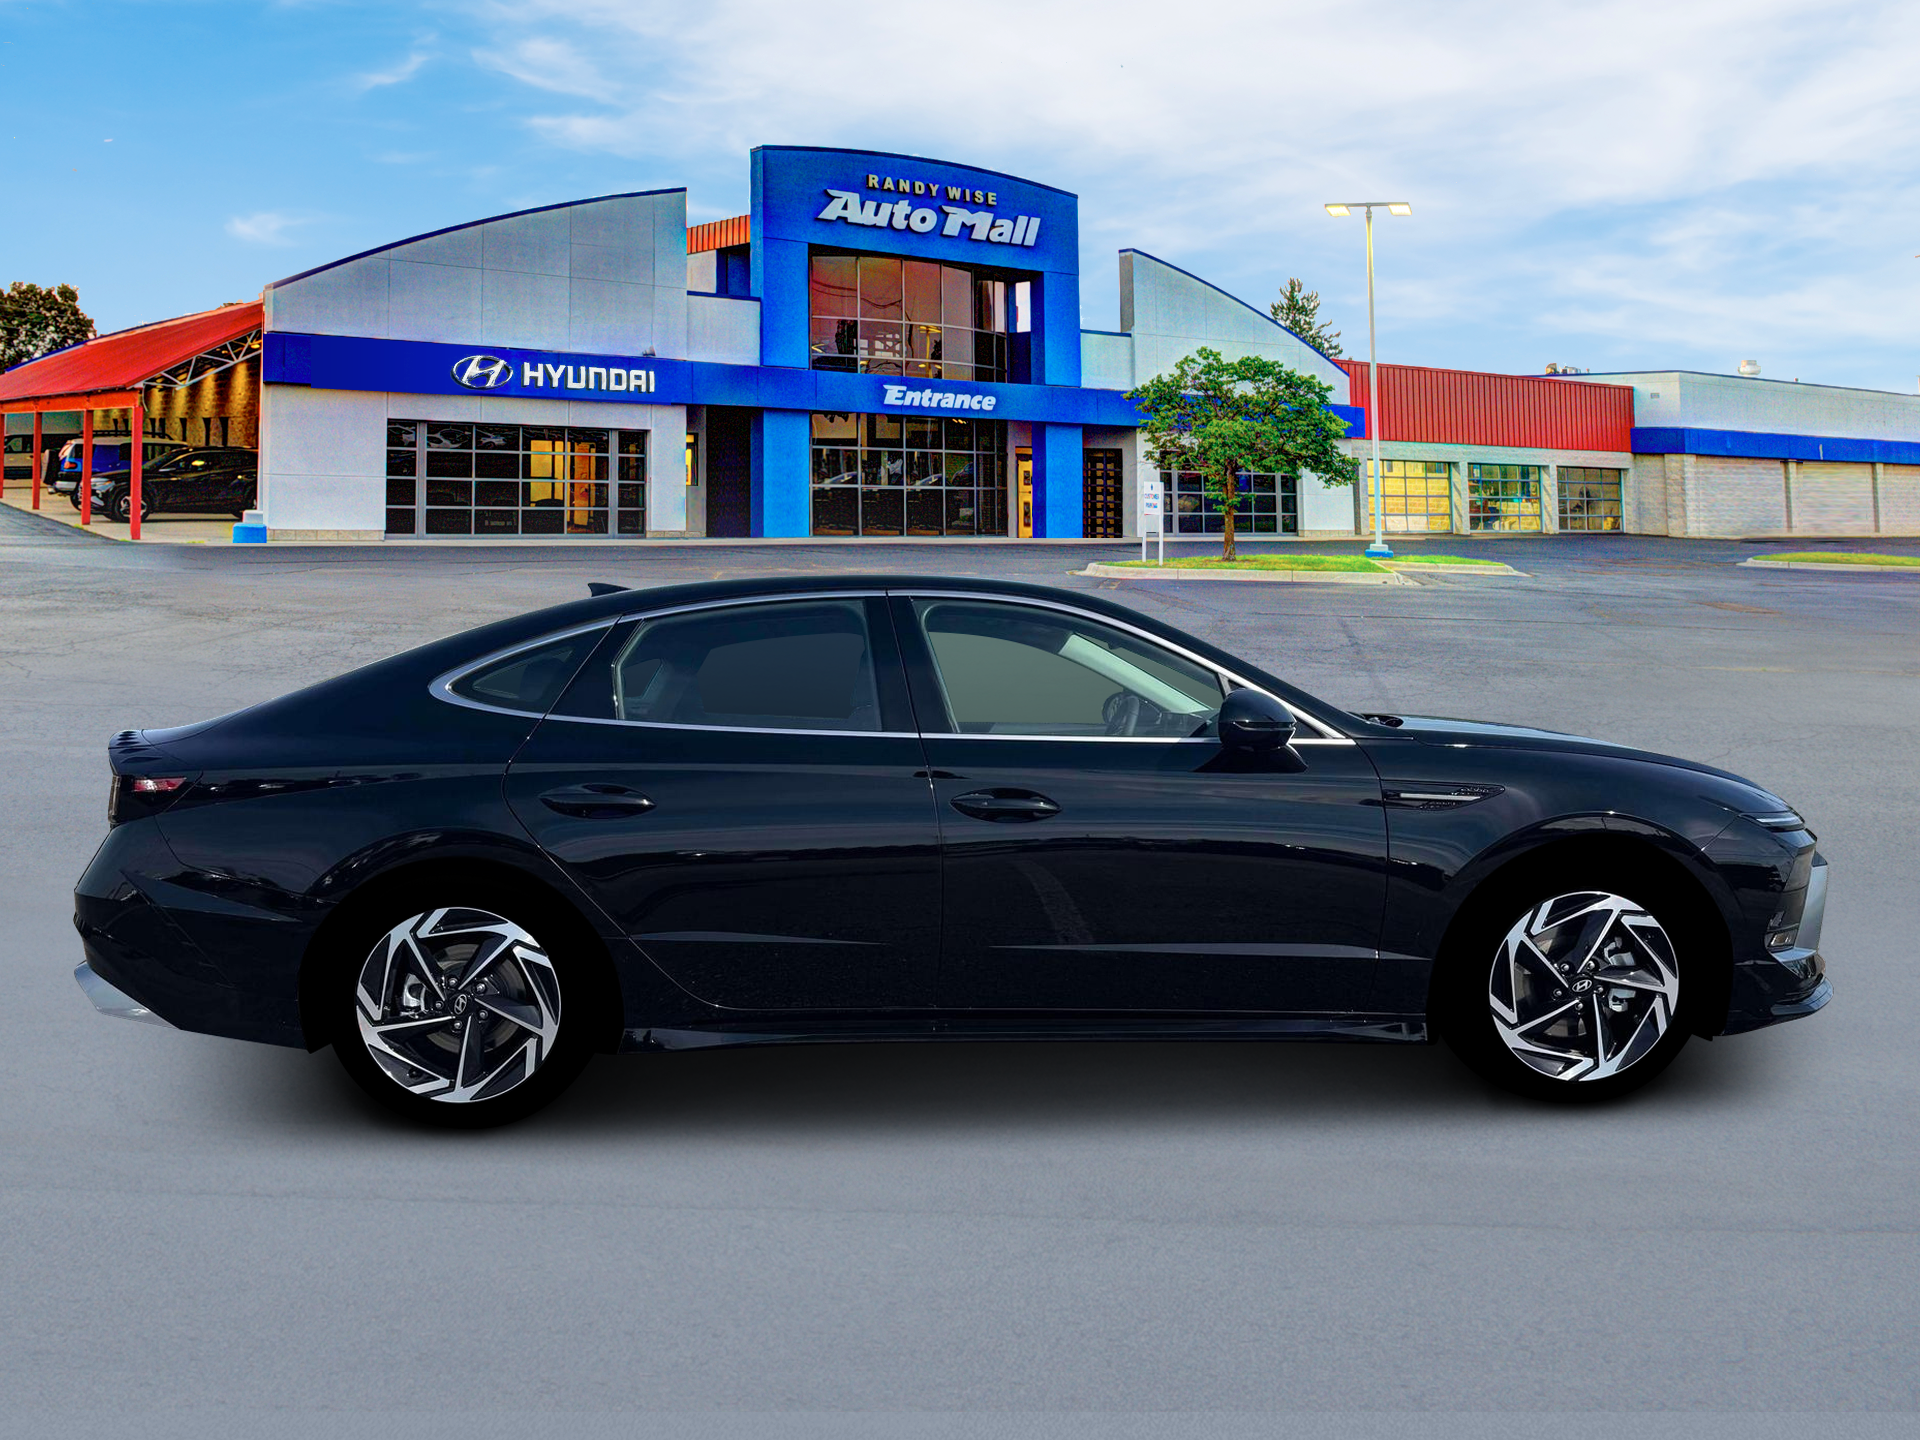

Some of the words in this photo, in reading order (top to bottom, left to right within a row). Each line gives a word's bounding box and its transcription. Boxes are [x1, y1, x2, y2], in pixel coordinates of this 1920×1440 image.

[867, 174, 939, 197] RANDY
[946, 187, 997, 206] WISE
[818, 189, 938, 233] Auto
[941, 205, 1041, 247] Mall
[523, 361, 655, 393] HYUNDAI
[883, 385, 997, 411] Entrance
